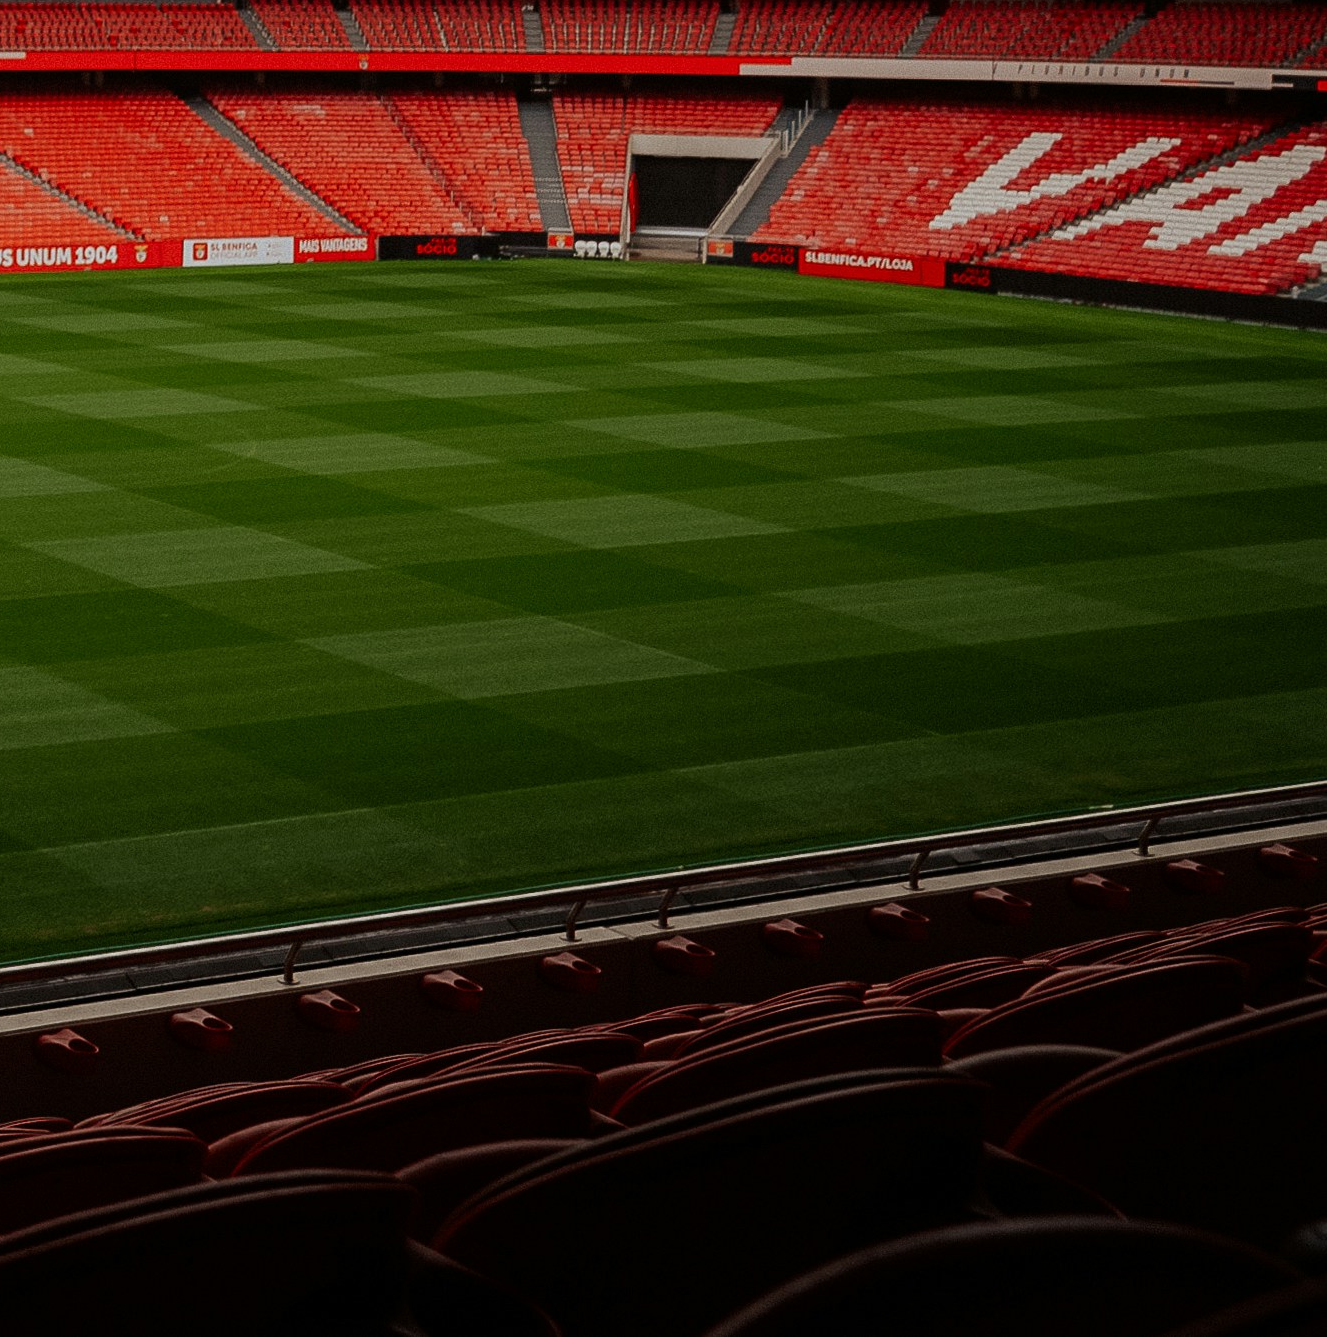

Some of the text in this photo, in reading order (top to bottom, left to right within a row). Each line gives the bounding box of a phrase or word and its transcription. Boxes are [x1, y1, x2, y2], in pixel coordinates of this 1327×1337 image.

[16, 246, 72, 267] UNUM
[75, 245, 118, 265] 1904
[299, 237, 368, 254] MAIS VANTAGENS
[804, 250, 914, 272] SLBENFICA.PT/LOJA
